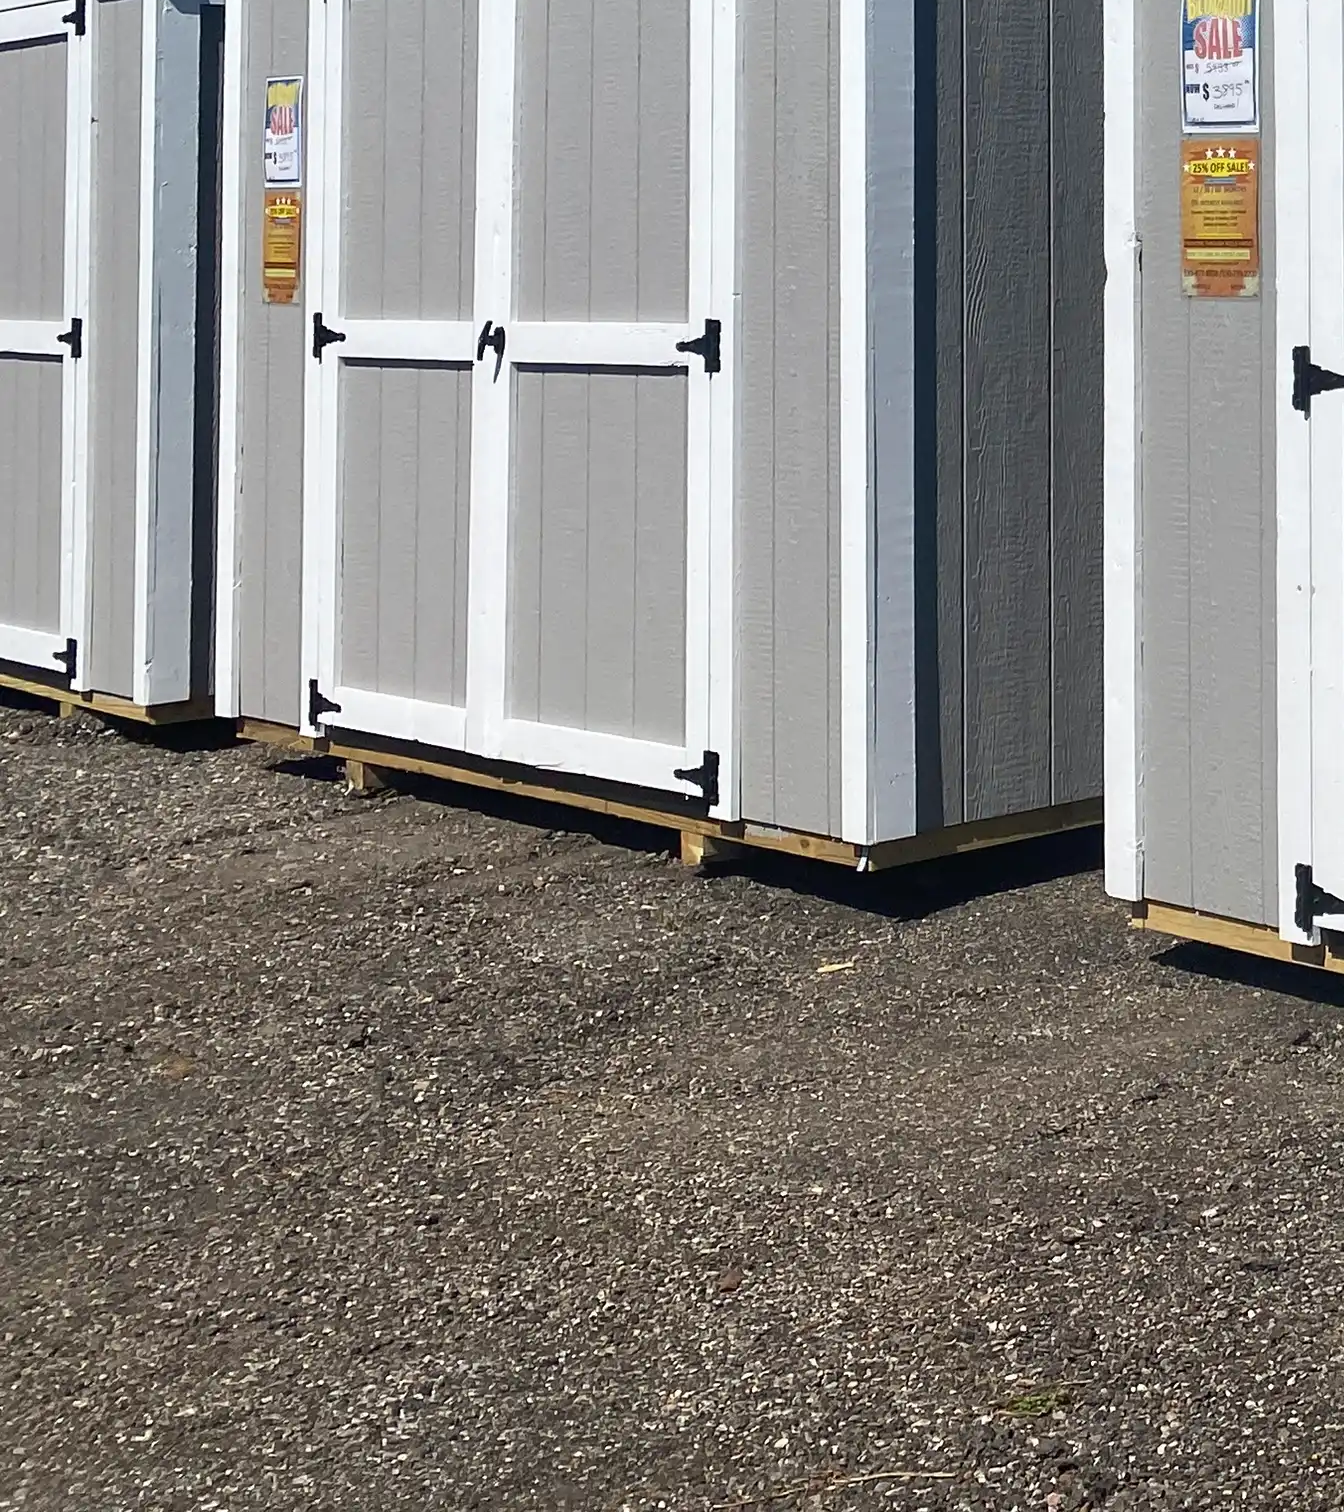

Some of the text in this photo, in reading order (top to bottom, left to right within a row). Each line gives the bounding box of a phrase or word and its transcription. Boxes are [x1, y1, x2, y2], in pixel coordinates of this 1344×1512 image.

[1194, 17, 1243, 60] SALE
[1202, 82, 1209, 102] $
[1193, 162, 1248, 173] 25% OFF SALE!
